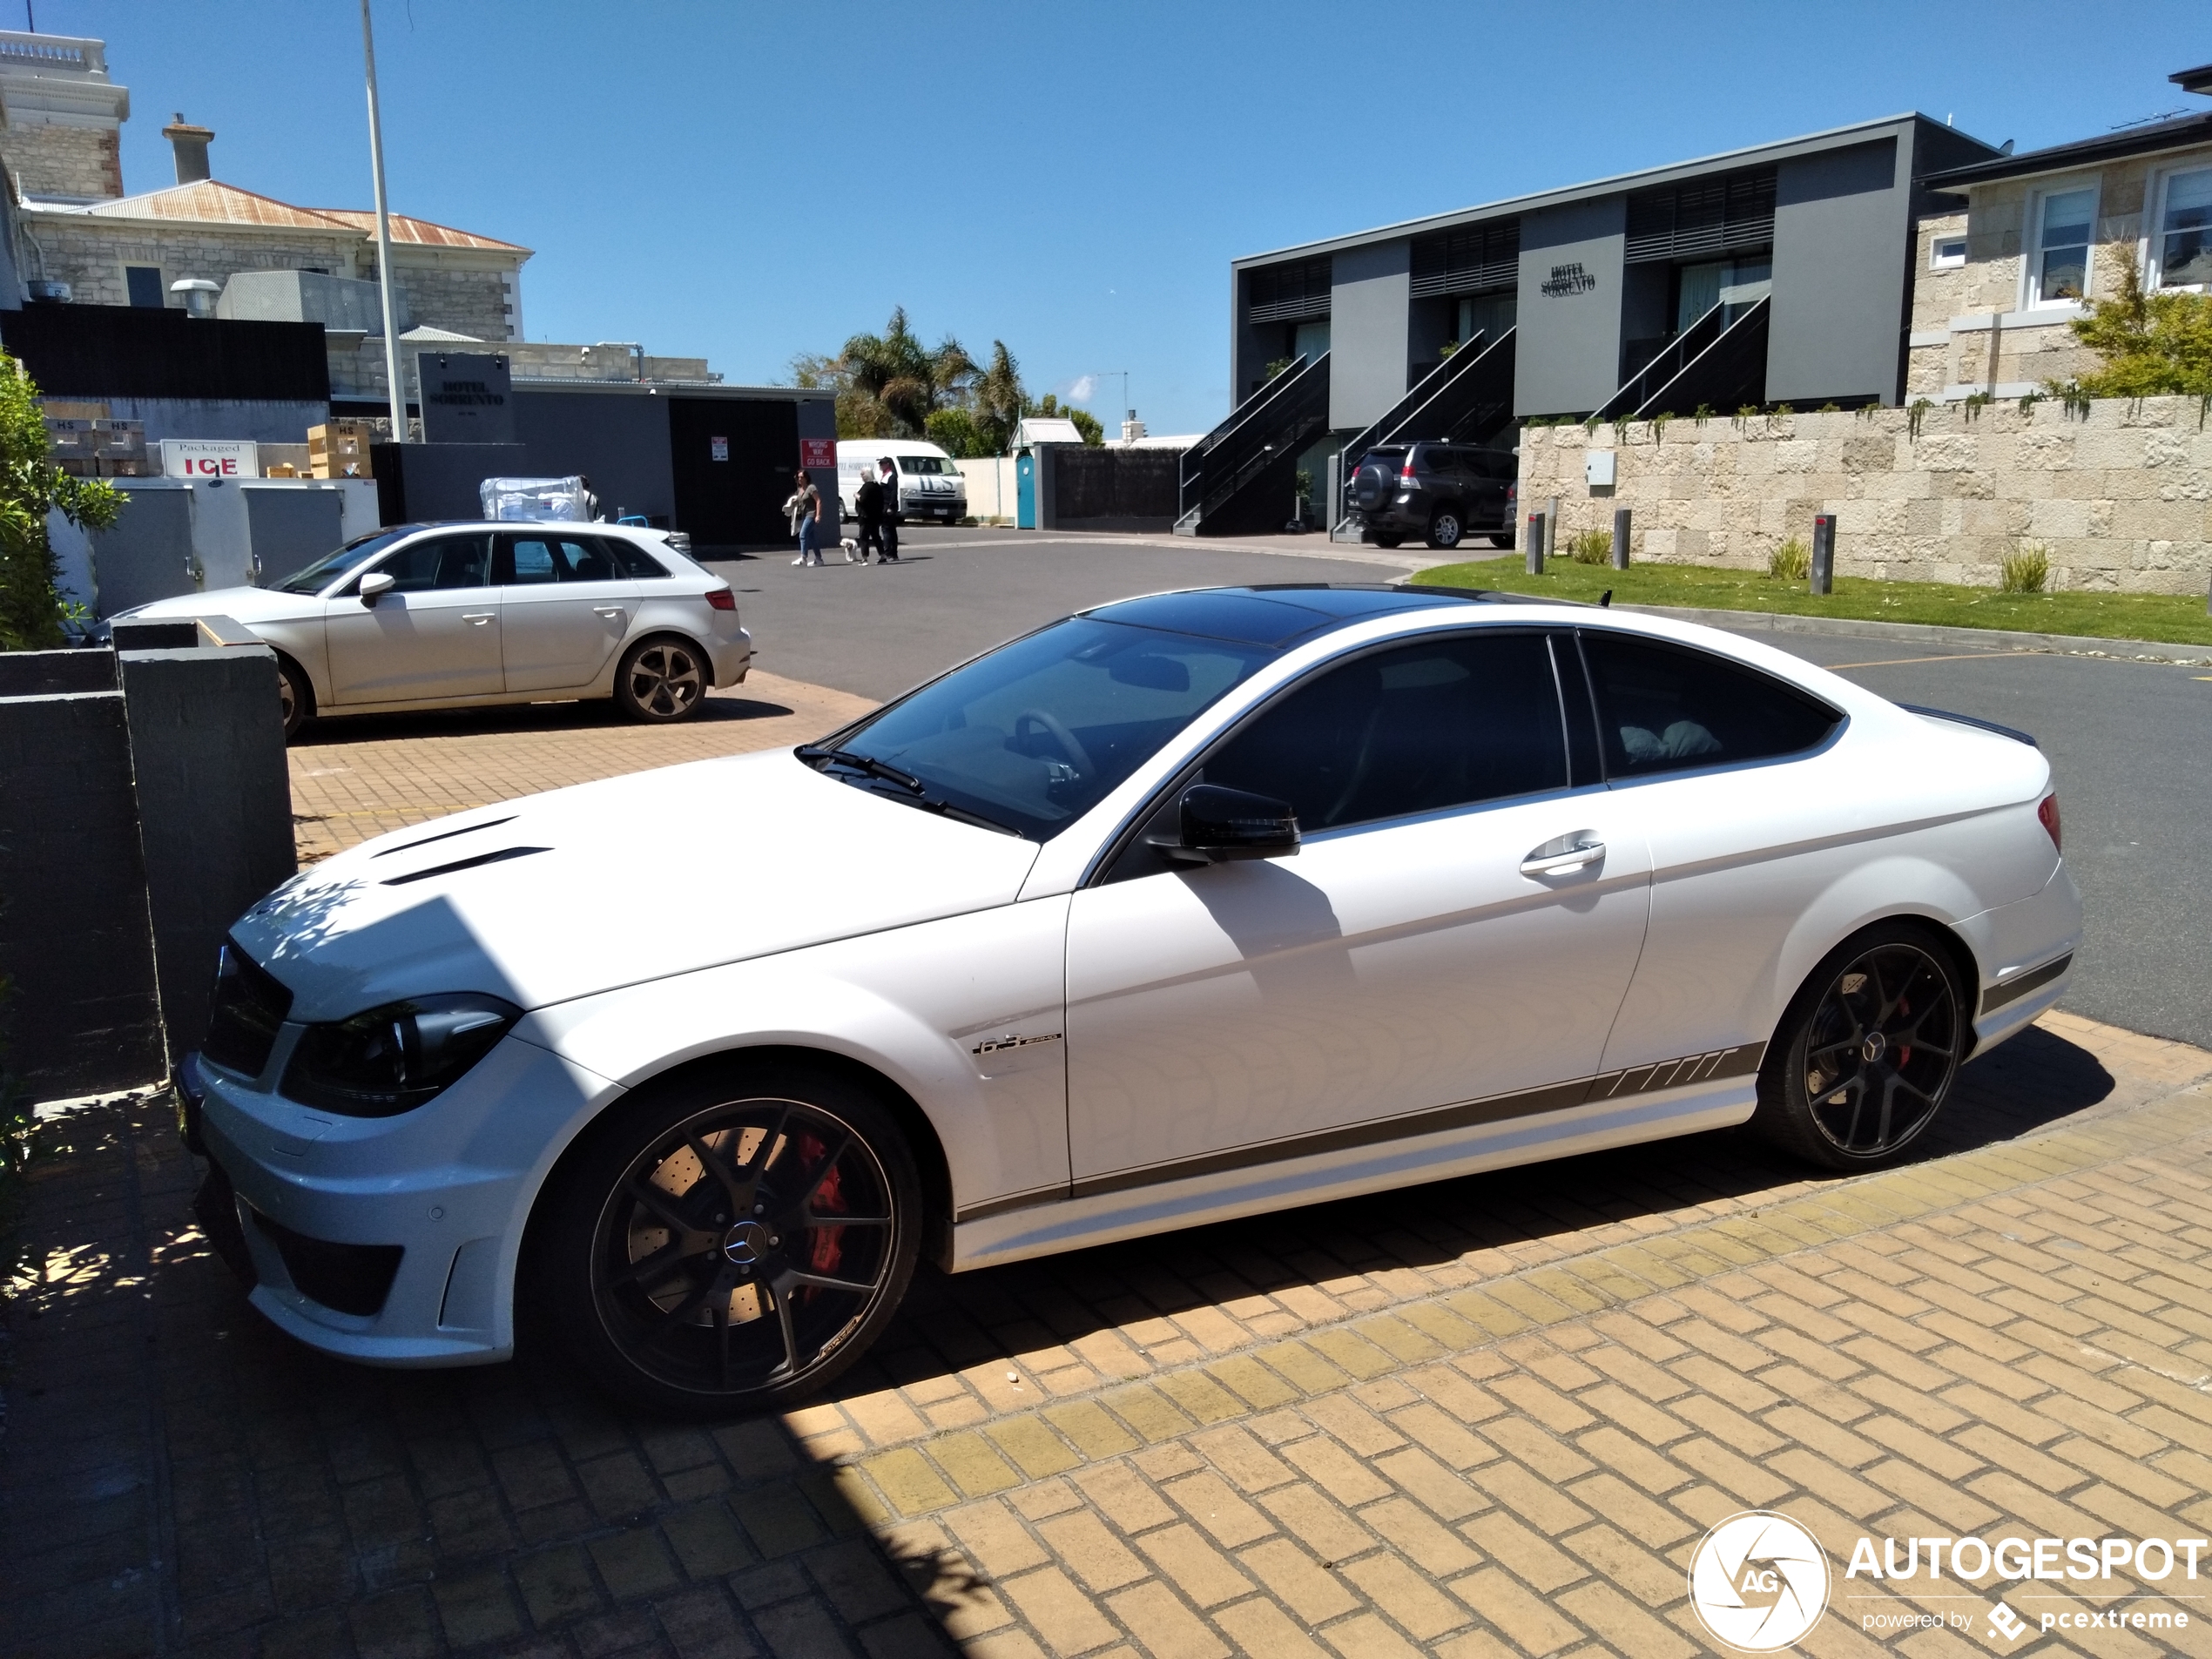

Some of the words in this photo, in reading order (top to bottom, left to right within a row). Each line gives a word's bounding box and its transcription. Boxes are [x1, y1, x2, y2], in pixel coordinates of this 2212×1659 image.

[1551, 262, 1584, 280] HOTEL
[442, 381, 489, 392] HOTEL
[429, 394, 504, 405] SORRENTO
[57, 421, 74, 429] HS
[179, 444, 240, 453] Packaged
[185, 458, 238, 475] ICE
[980, 1034, 1022, 1055] 63
